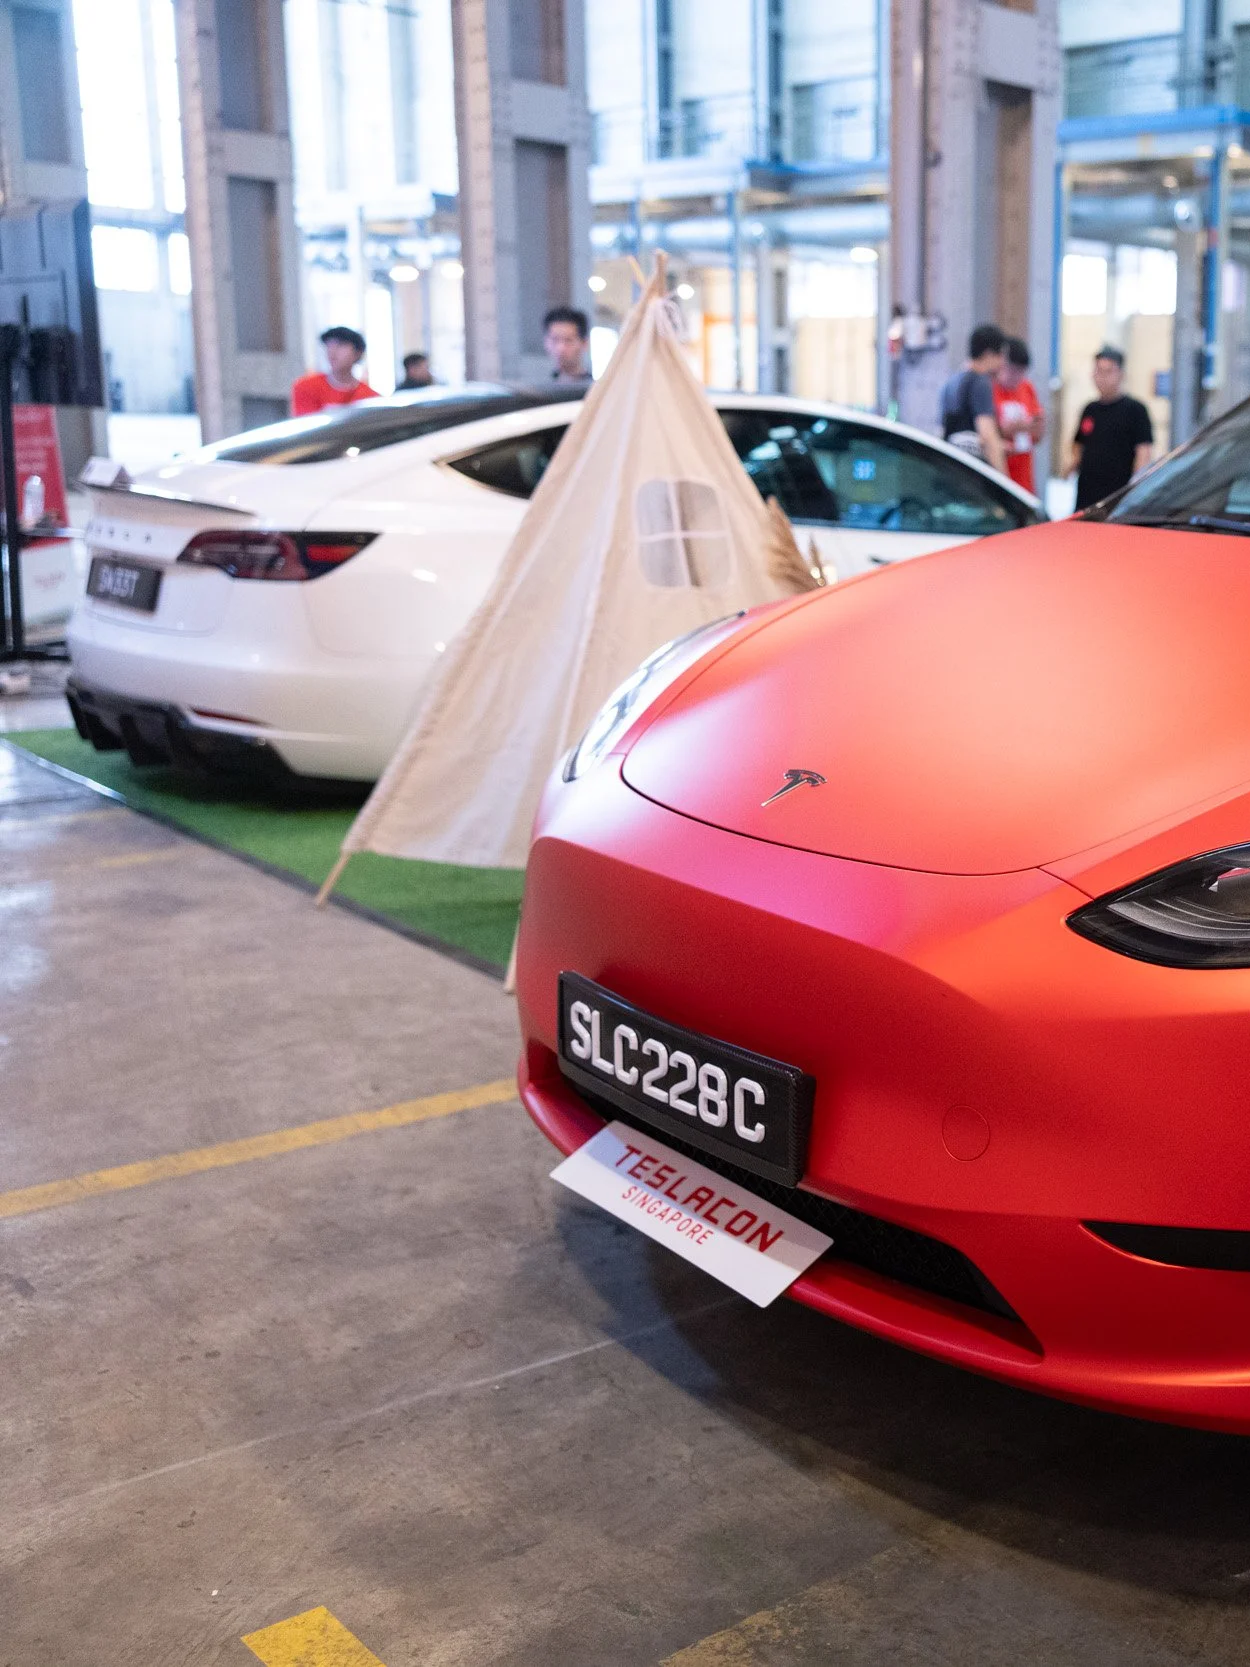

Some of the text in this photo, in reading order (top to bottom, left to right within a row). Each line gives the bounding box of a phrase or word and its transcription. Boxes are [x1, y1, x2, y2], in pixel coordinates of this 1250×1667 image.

[570, 1000, 766, 1143] SLC228C
[615, 1144, 785, 1253] TESLACON
[622, 1185, 714, 1245] SINGAPORE
